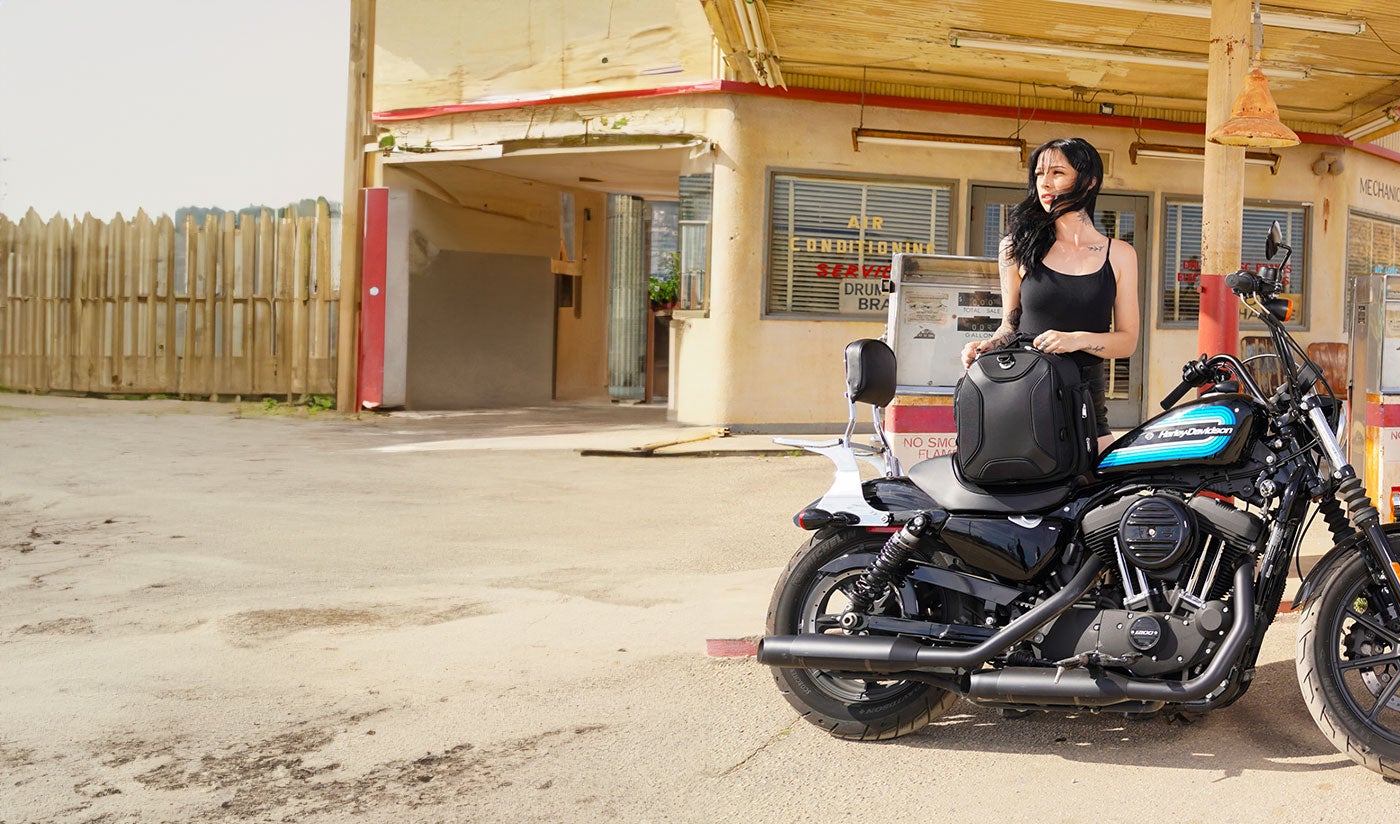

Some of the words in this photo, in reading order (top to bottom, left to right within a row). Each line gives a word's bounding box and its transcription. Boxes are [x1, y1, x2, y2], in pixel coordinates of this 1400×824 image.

[1360, 177, 1400, 203] MECHANIC
[847, 215, 884, 230] AIR
[789, 237, 935, 255] CONDITIONING
[903, 437, 923, 448] NO
